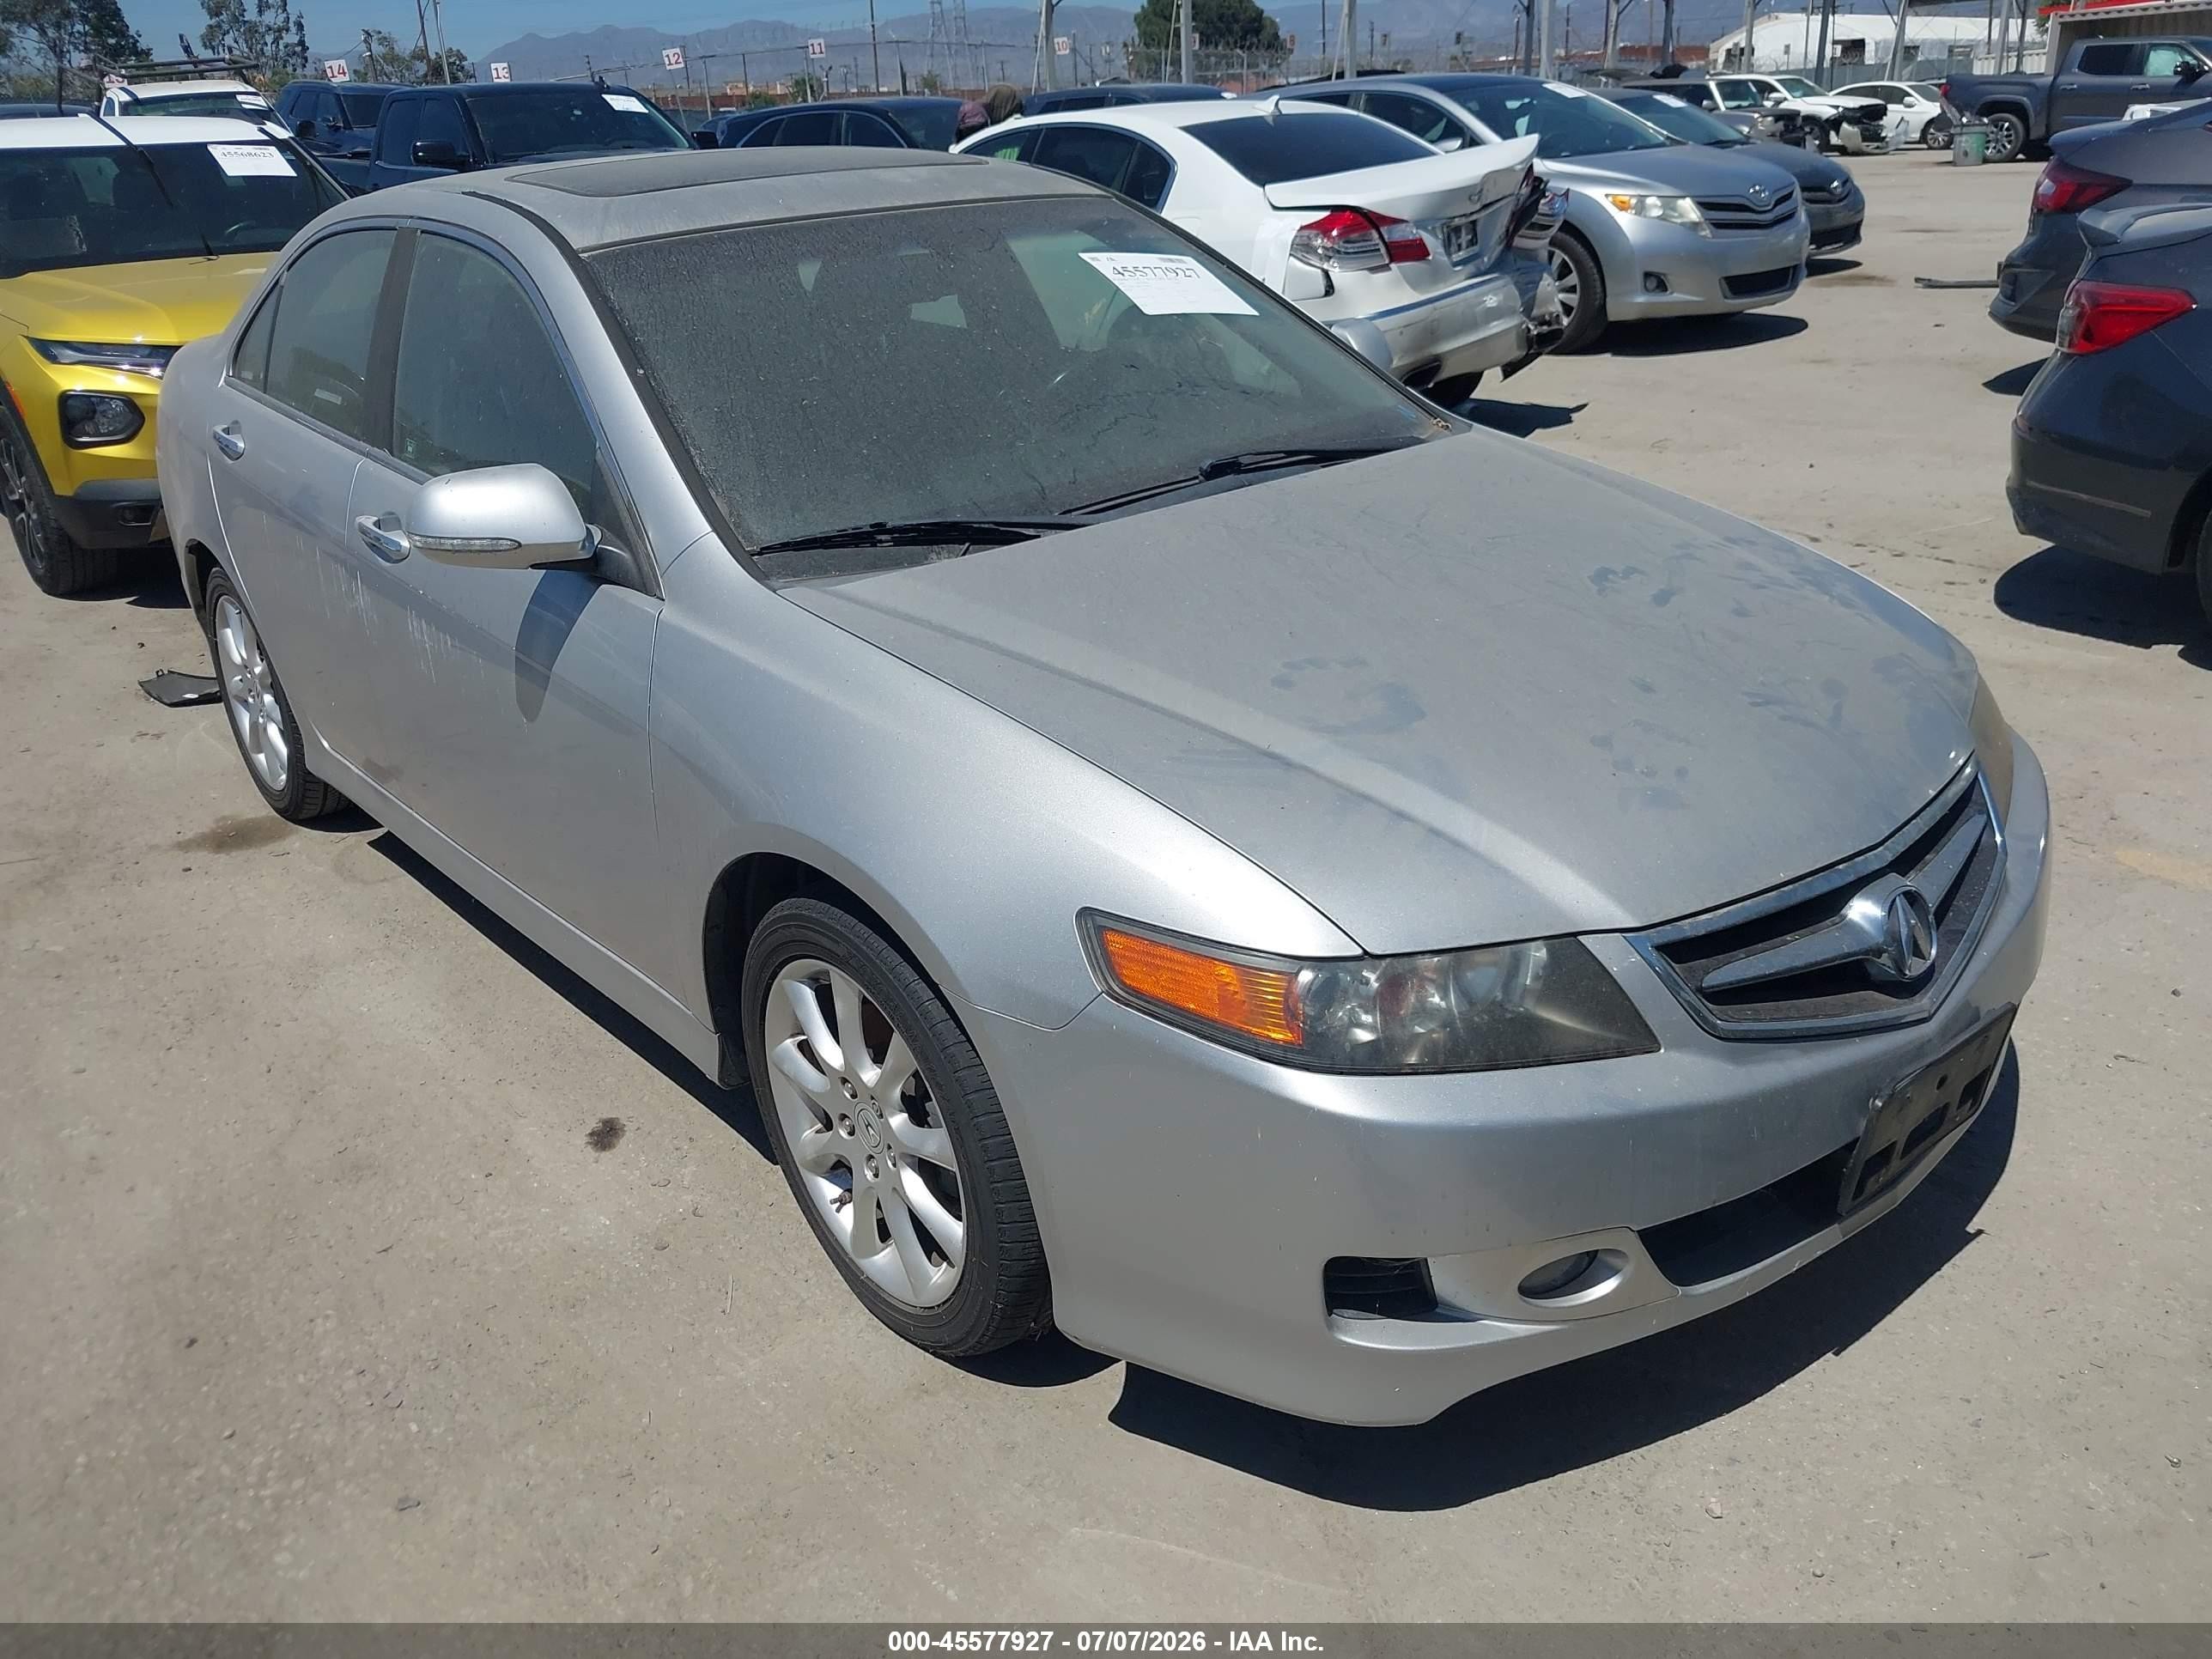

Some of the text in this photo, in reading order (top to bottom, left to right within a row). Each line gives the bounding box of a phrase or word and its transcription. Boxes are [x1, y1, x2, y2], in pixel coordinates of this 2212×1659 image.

[810, 43, 823, 55] 11
[1057, 40, 1067, 52] 10
[665, 52, 682, 66] 12
[327, 64, 347, 78] 14
[493, 67, 508, 79] 13
[1112, 266, 1200, 279] 45577927
